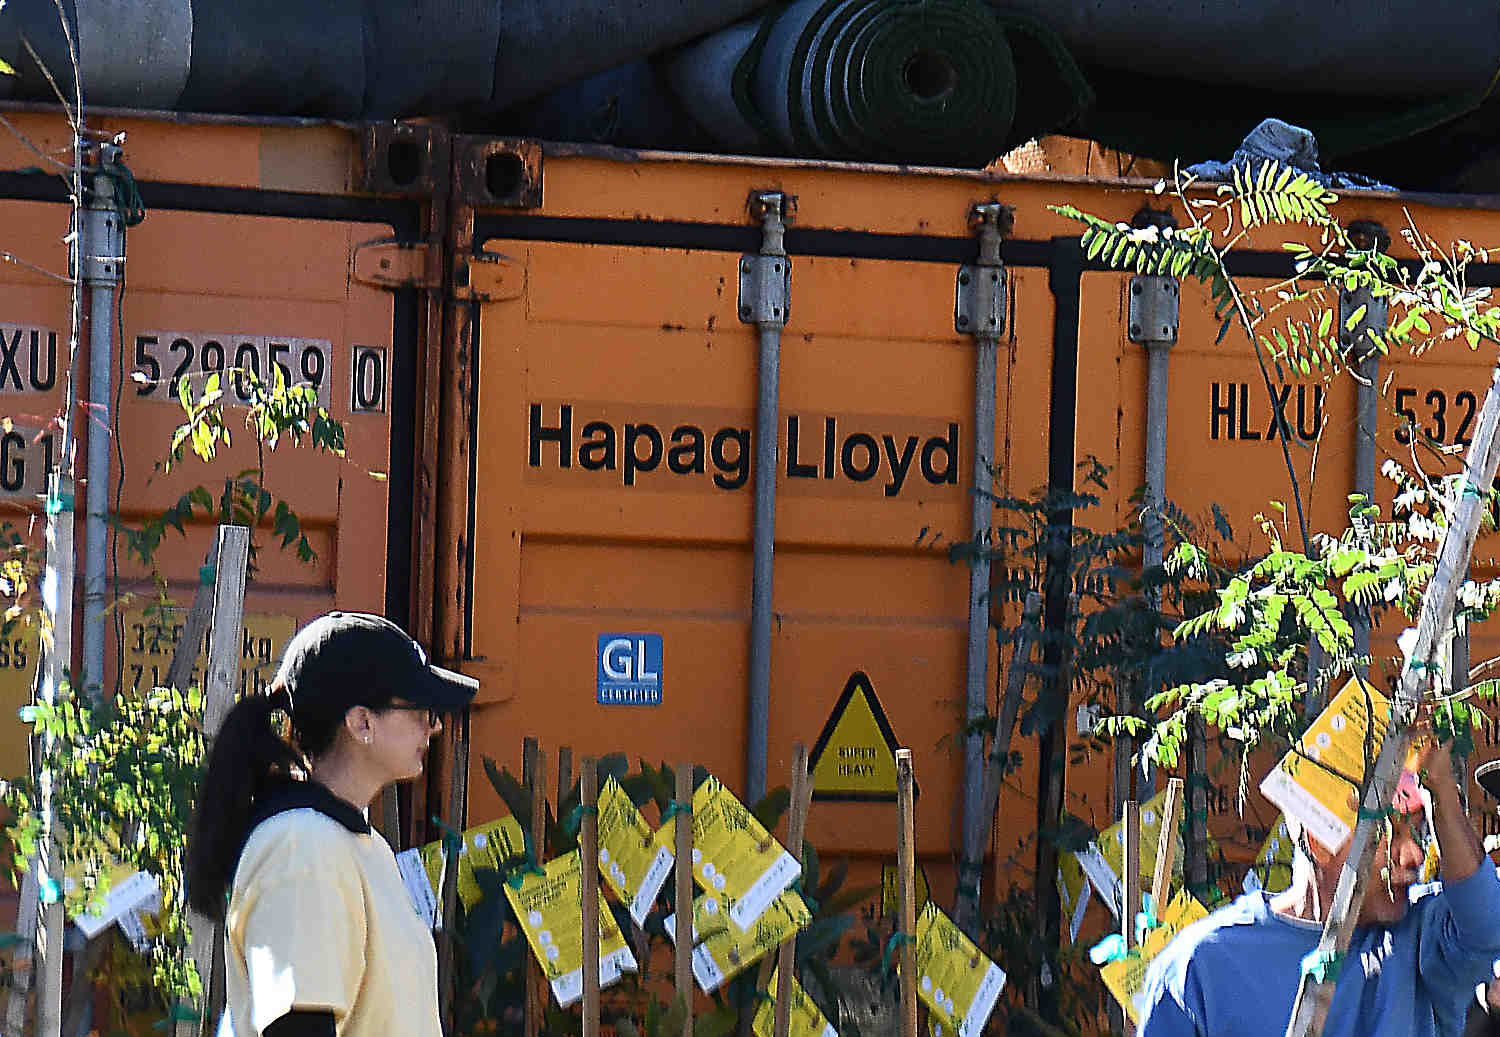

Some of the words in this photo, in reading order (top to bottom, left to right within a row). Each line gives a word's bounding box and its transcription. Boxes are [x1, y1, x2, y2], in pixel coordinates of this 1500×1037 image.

[356, 350, 383, 408] 0
[1210, 383, 1323, 441] HLXU
[528, 403, 751, 491] Hapag
[786, 415, 959, 497] Lloyd
[602, 639, 658, 682] GL
[839, 765, 873, 777] HEAVY
